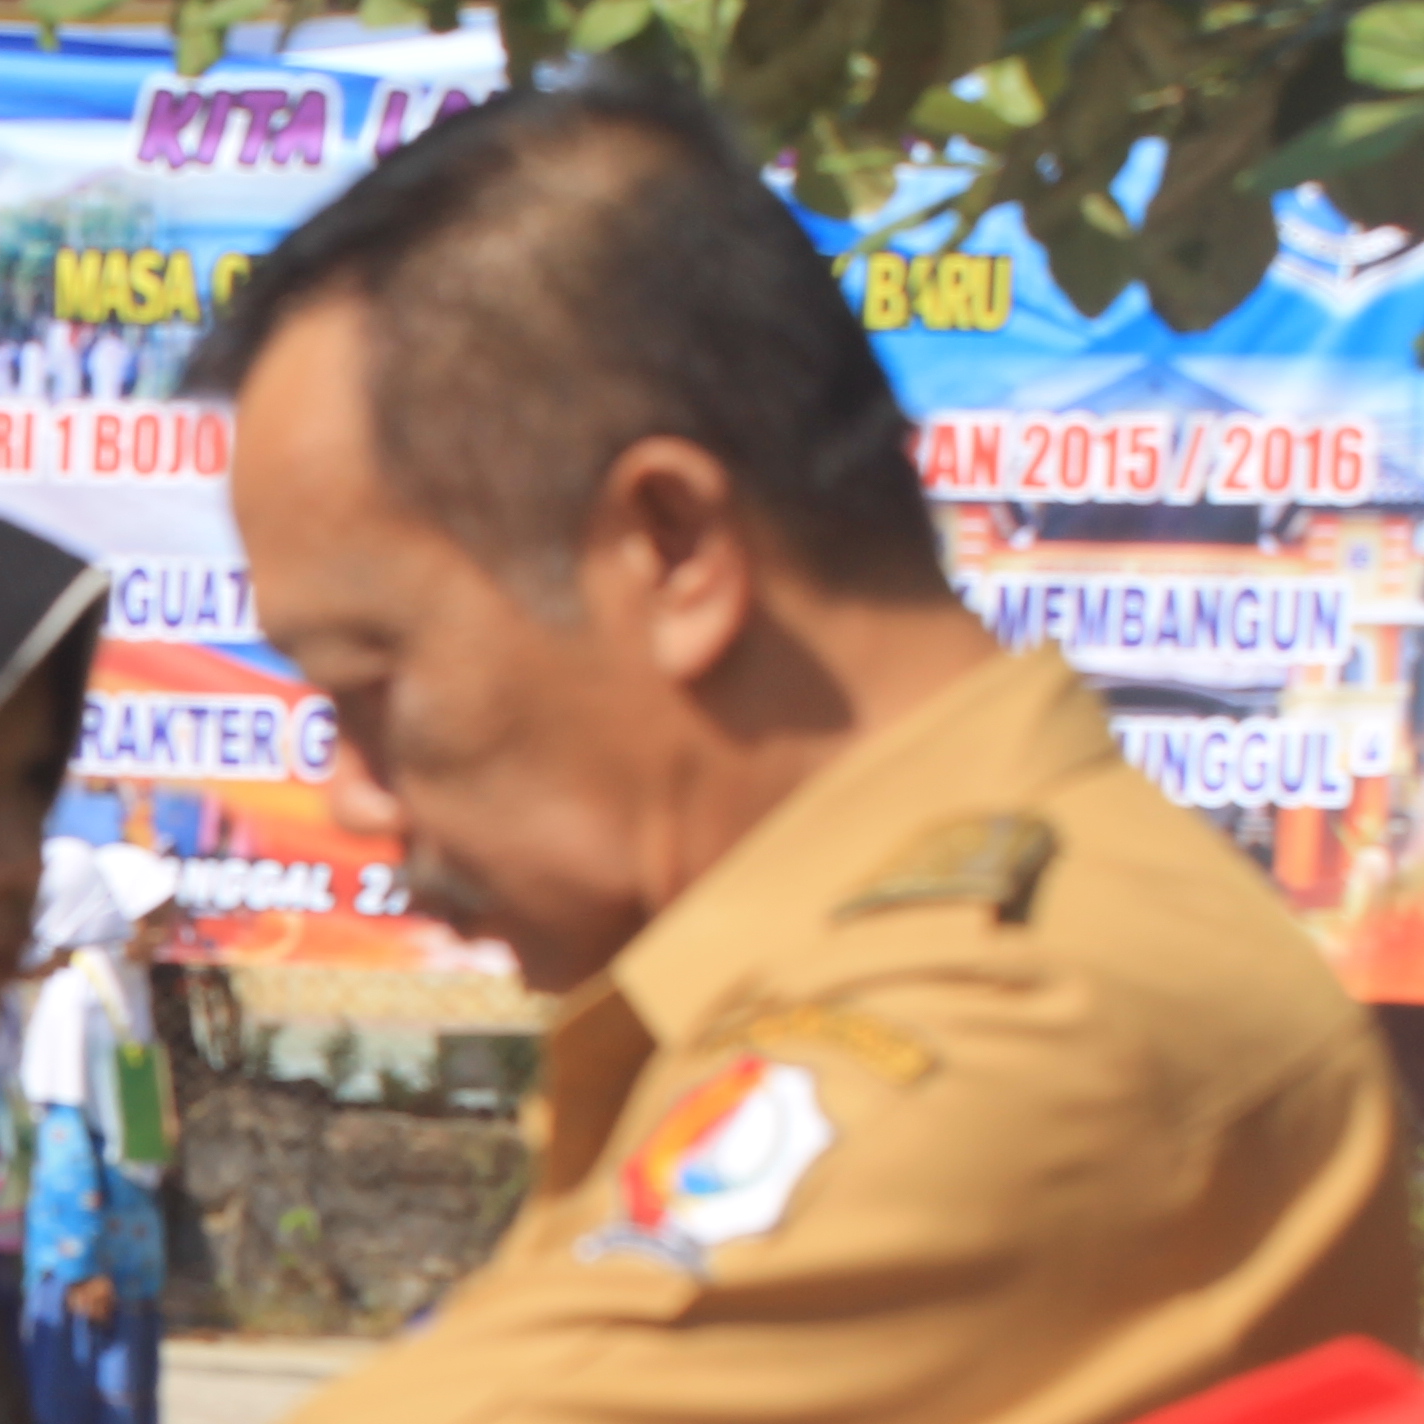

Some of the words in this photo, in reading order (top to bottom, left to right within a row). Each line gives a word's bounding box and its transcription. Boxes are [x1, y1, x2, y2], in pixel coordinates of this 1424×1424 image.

[137, 88, 327, 168] KITA
[54, 247, 200, 325] MASA
[56, 413, 72, 471] 1
[908, 423, 1002, 487] AN
[1020, 423, 1159, 489] 2015
[1221, 427, 1364, 493] 2016
[105, 567, 251, 628] GUAT
[996, 586, 1341, 650] MEMBANGUN
